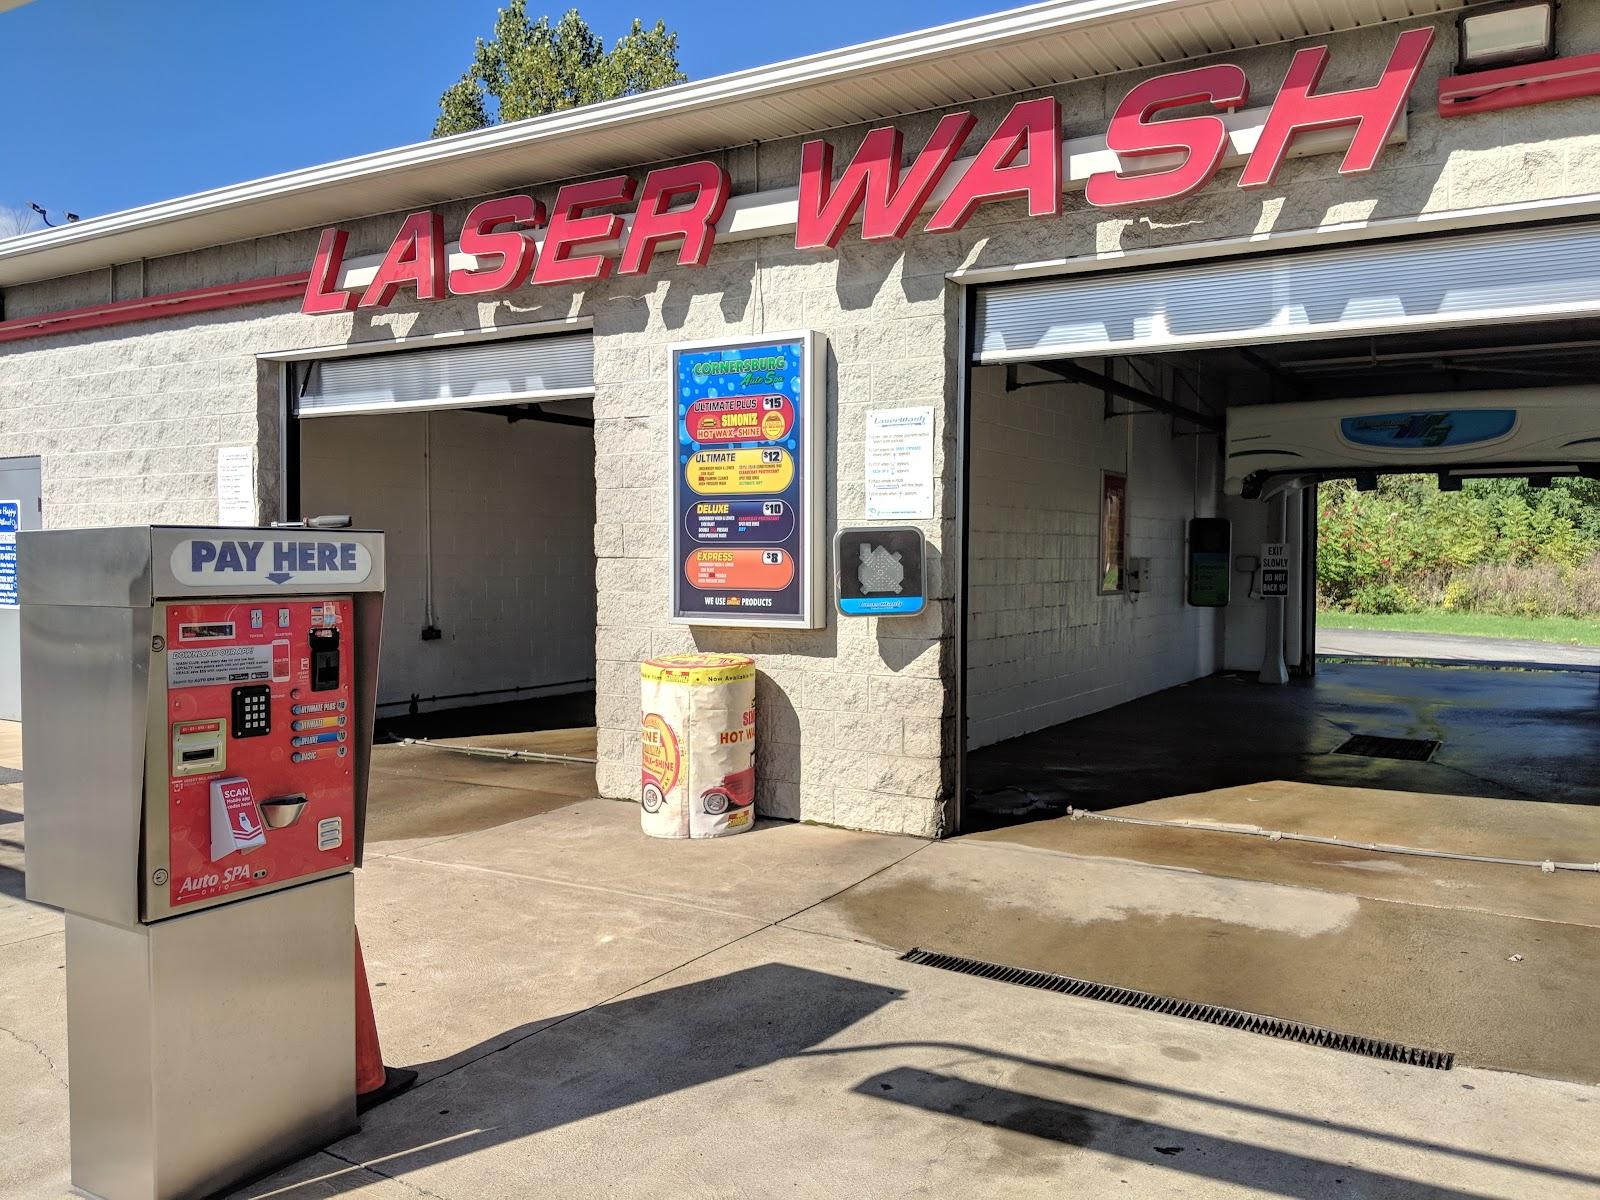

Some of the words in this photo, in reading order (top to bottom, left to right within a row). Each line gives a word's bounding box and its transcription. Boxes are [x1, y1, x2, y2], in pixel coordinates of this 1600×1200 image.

[301, 160, 730, 315] LASER
[795, 26, 1436, 250] WASH
[694, 356, 785, 375] CORNERSBURG
[740, 373, 763, 386] Auto
[764, 371, 785, 386] Spa
[694, 401, 734, 412] ULTIMATE
[736, 400, 757, 409] PLUS
[764, 398, 782, 409] $15
[722, 412, 758, 427] SIMONIZ
[698, 429, 714, 439] HOT
[695, 452, 736, 463] ULTIMATE
[764, 451, 780, 462] $12
[697, 504, 729, 514] DELUXE
[765, 504, 781, 514] $10
[192, 540, 264, 572] PAY
[273, 542, 357, 572] HERE
[1268, 546, 1283, 555] EXIT
[697, 552, 734, 561] EXPRESS
[767, 553, 778, 563] $8
[1263, 558, 1288, 568] SLOWLY
[704, 597, 714, 605] WE
[715, 597, 726, 606] USE
[742, 597, 772, 607] PRODUCTS
[173, 650, 219, 659] DOWNLOAD
[220, 648, 236, 656] OUR
[720, 730, 743, 744] HOT
[224, 787, 249, 798] SCAN
[179, 874, 219, 894] Auto
[222, 864, 250, 884] SPA
[201, 884, 229, 895] OHIO
